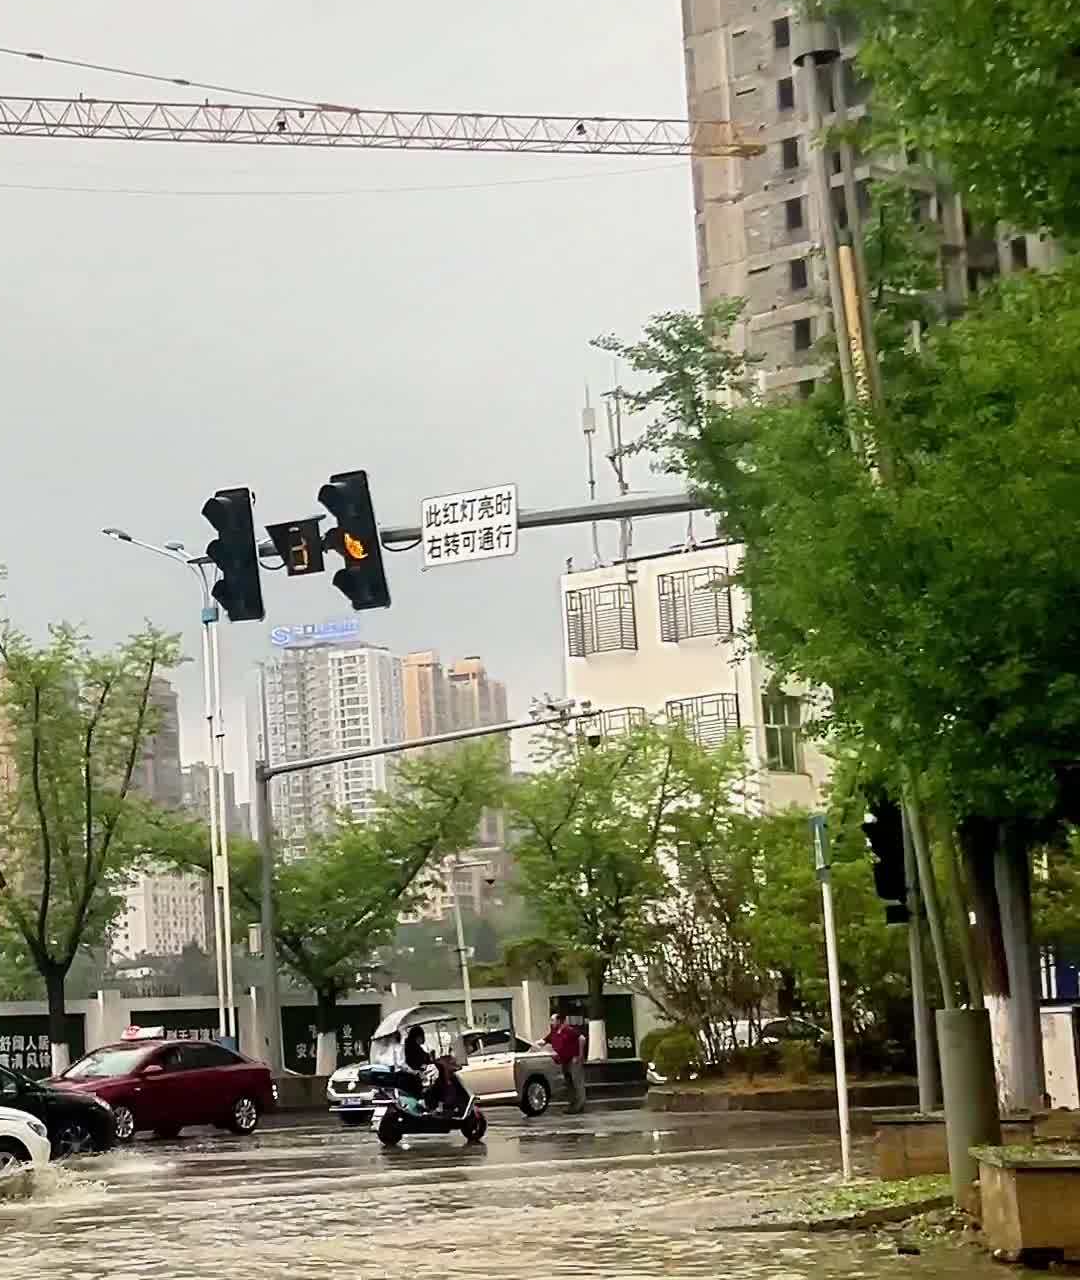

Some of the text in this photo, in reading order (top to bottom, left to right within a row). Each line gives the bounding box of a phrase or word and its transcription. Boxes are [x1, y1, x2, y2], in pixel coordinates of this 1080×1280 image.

[426, 491, 513, 528] 此红灯亮时
[427, 524, 513, 559] 右转可通行
